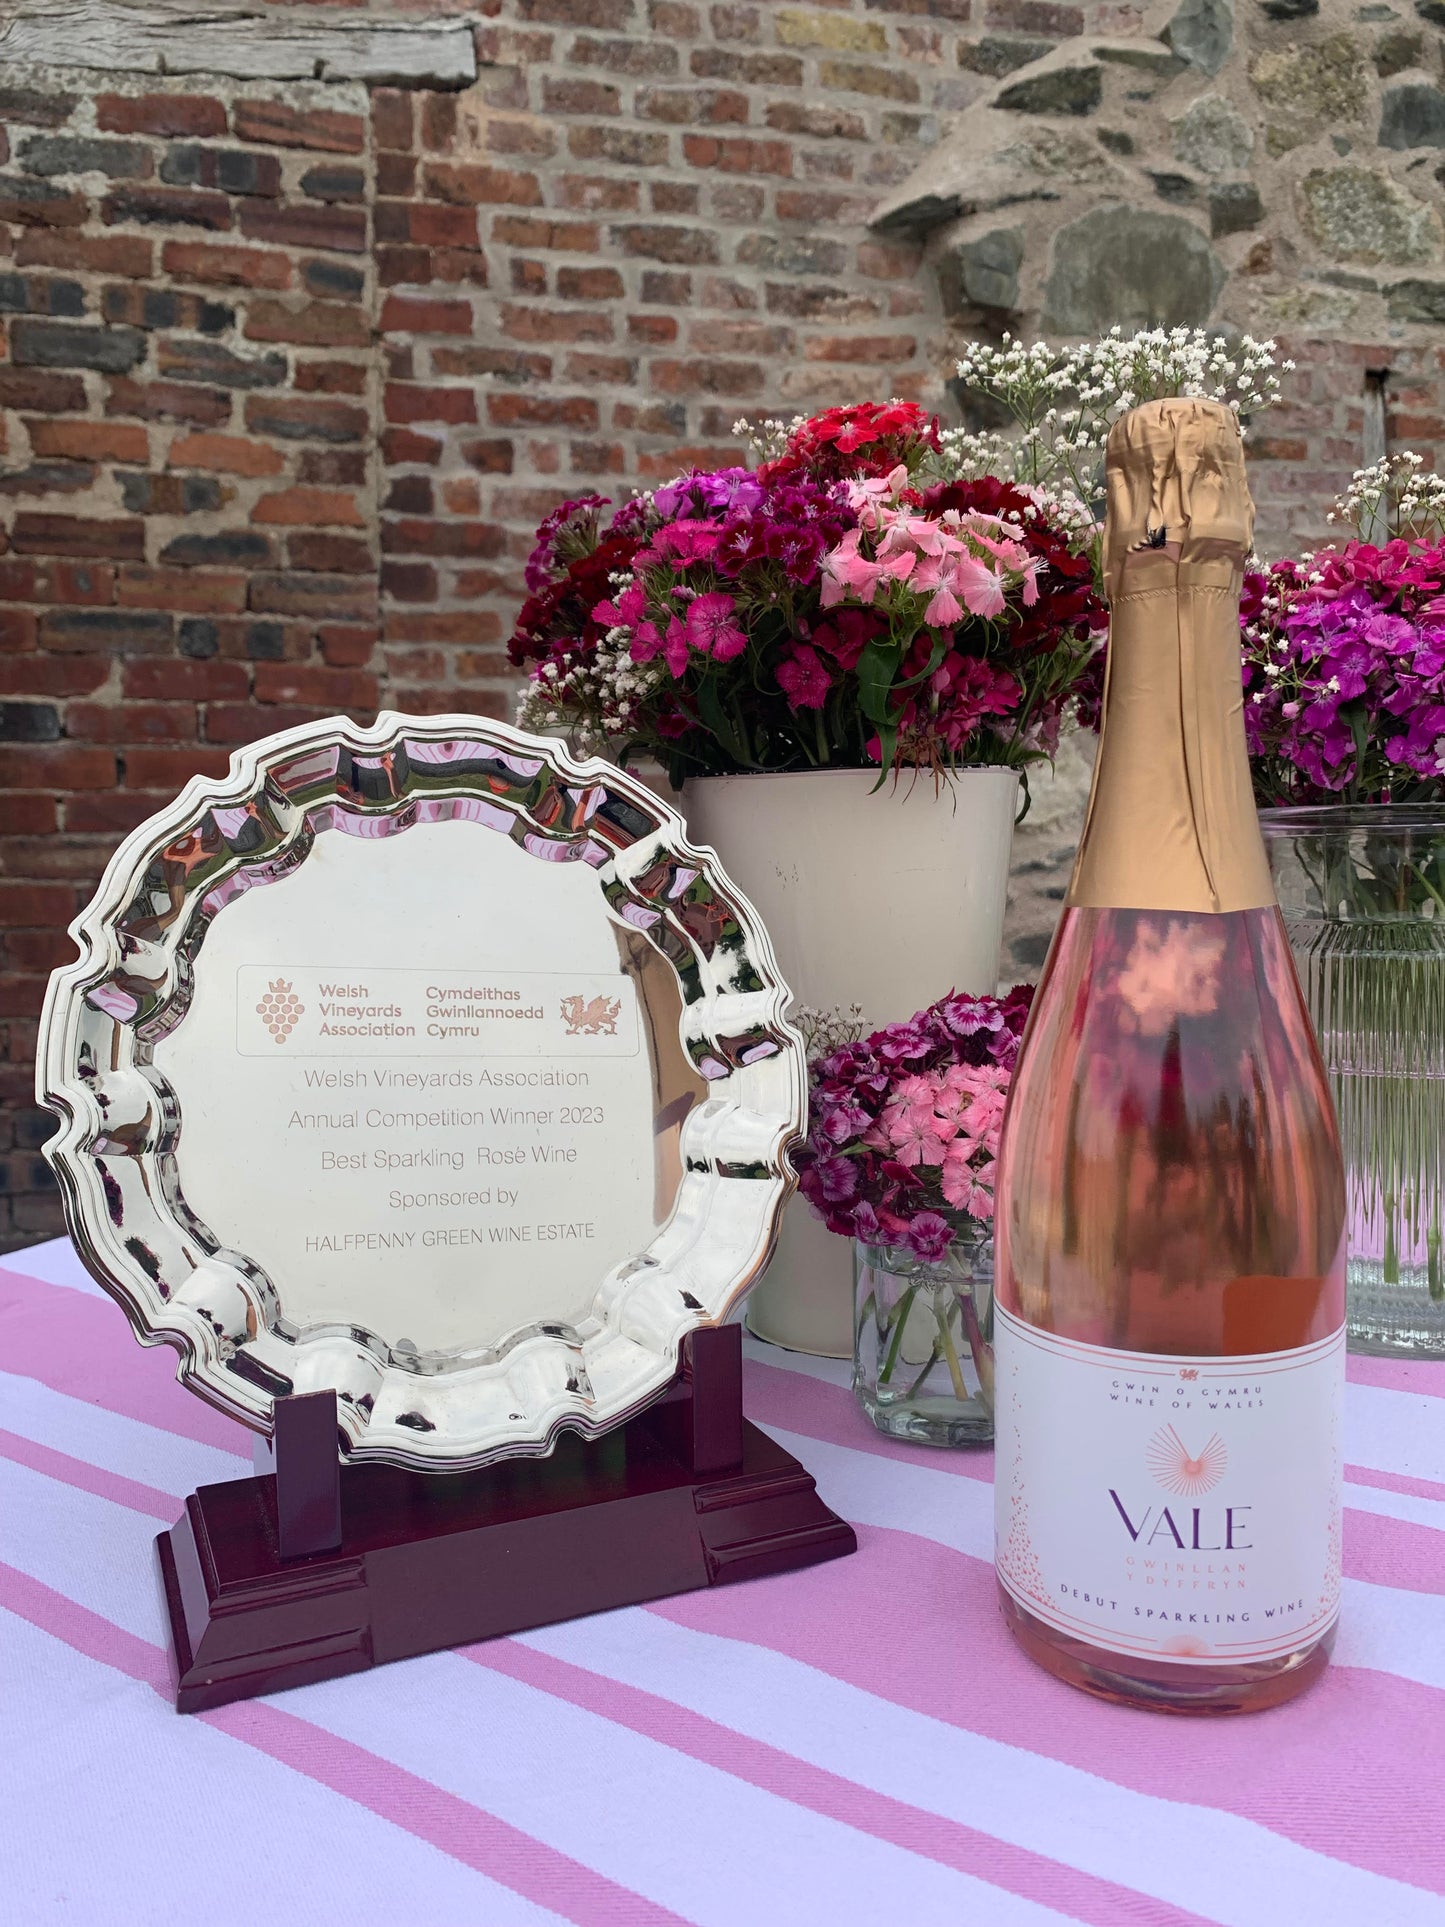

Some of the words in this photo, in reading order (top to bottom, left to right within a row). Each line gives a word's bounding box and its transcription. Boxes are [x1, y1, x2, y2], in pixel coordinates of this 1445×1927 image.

[319, 983, 369, 998] Welsh
[426, 986, 521, 1003] Cymdeithas
[319, 1003, 402, 1021] Vineyards
[426, 1005, 544, 1020] Gwinllannoedd
[319, 1022, 416, 1037] Association
[426, 1024, 480, 1039] Cymru
[304, 1069, 367, 1088] Welsh
[373, 1069, 473, 1090] Vineyards
[479, 1069, 589, 1086] Association
[288, 1110, 359, 1128] Annual
[366, 1108, 484, 1131] Competition
[490, 1107, 554, 1125] Winner
[560, 1107, 604, 1124] 2023
[321, 1151, 367, 1170] Best
[373, 1148, 464, 1171] Sparkling
[477, 1145, 526, 1166] Rosé
[531, 1145, 577, 1163] Wine
[388, 1189, 492, 1210] Sponsored
[497, 1187, 518, 1207] by
[305, 1232, 416, 1253] HALFPENNY
[422, 1229, 483, 1247] GREEN
[488, 1226, 531, 1243] WINE
[537, 1223, 594, 1240] ESTATE
[1112, 1380, 1160, 1394] GWIN
[1201, 1386, 1262, 1396] GYMRU
[1109, 1393, 1155, 1407] WINE
[1171, 1401, 1193, 1409] OF
[1209, 1400, 1264, 1409] WALES
[1108, 1488, 1253, 1550] VALE
[1060, 1583, 1118, 1610] DEBUT
[1134, 1607, 1250, 1623] SPARKLING
[1265, 1599, 1304, 1618] WINE
